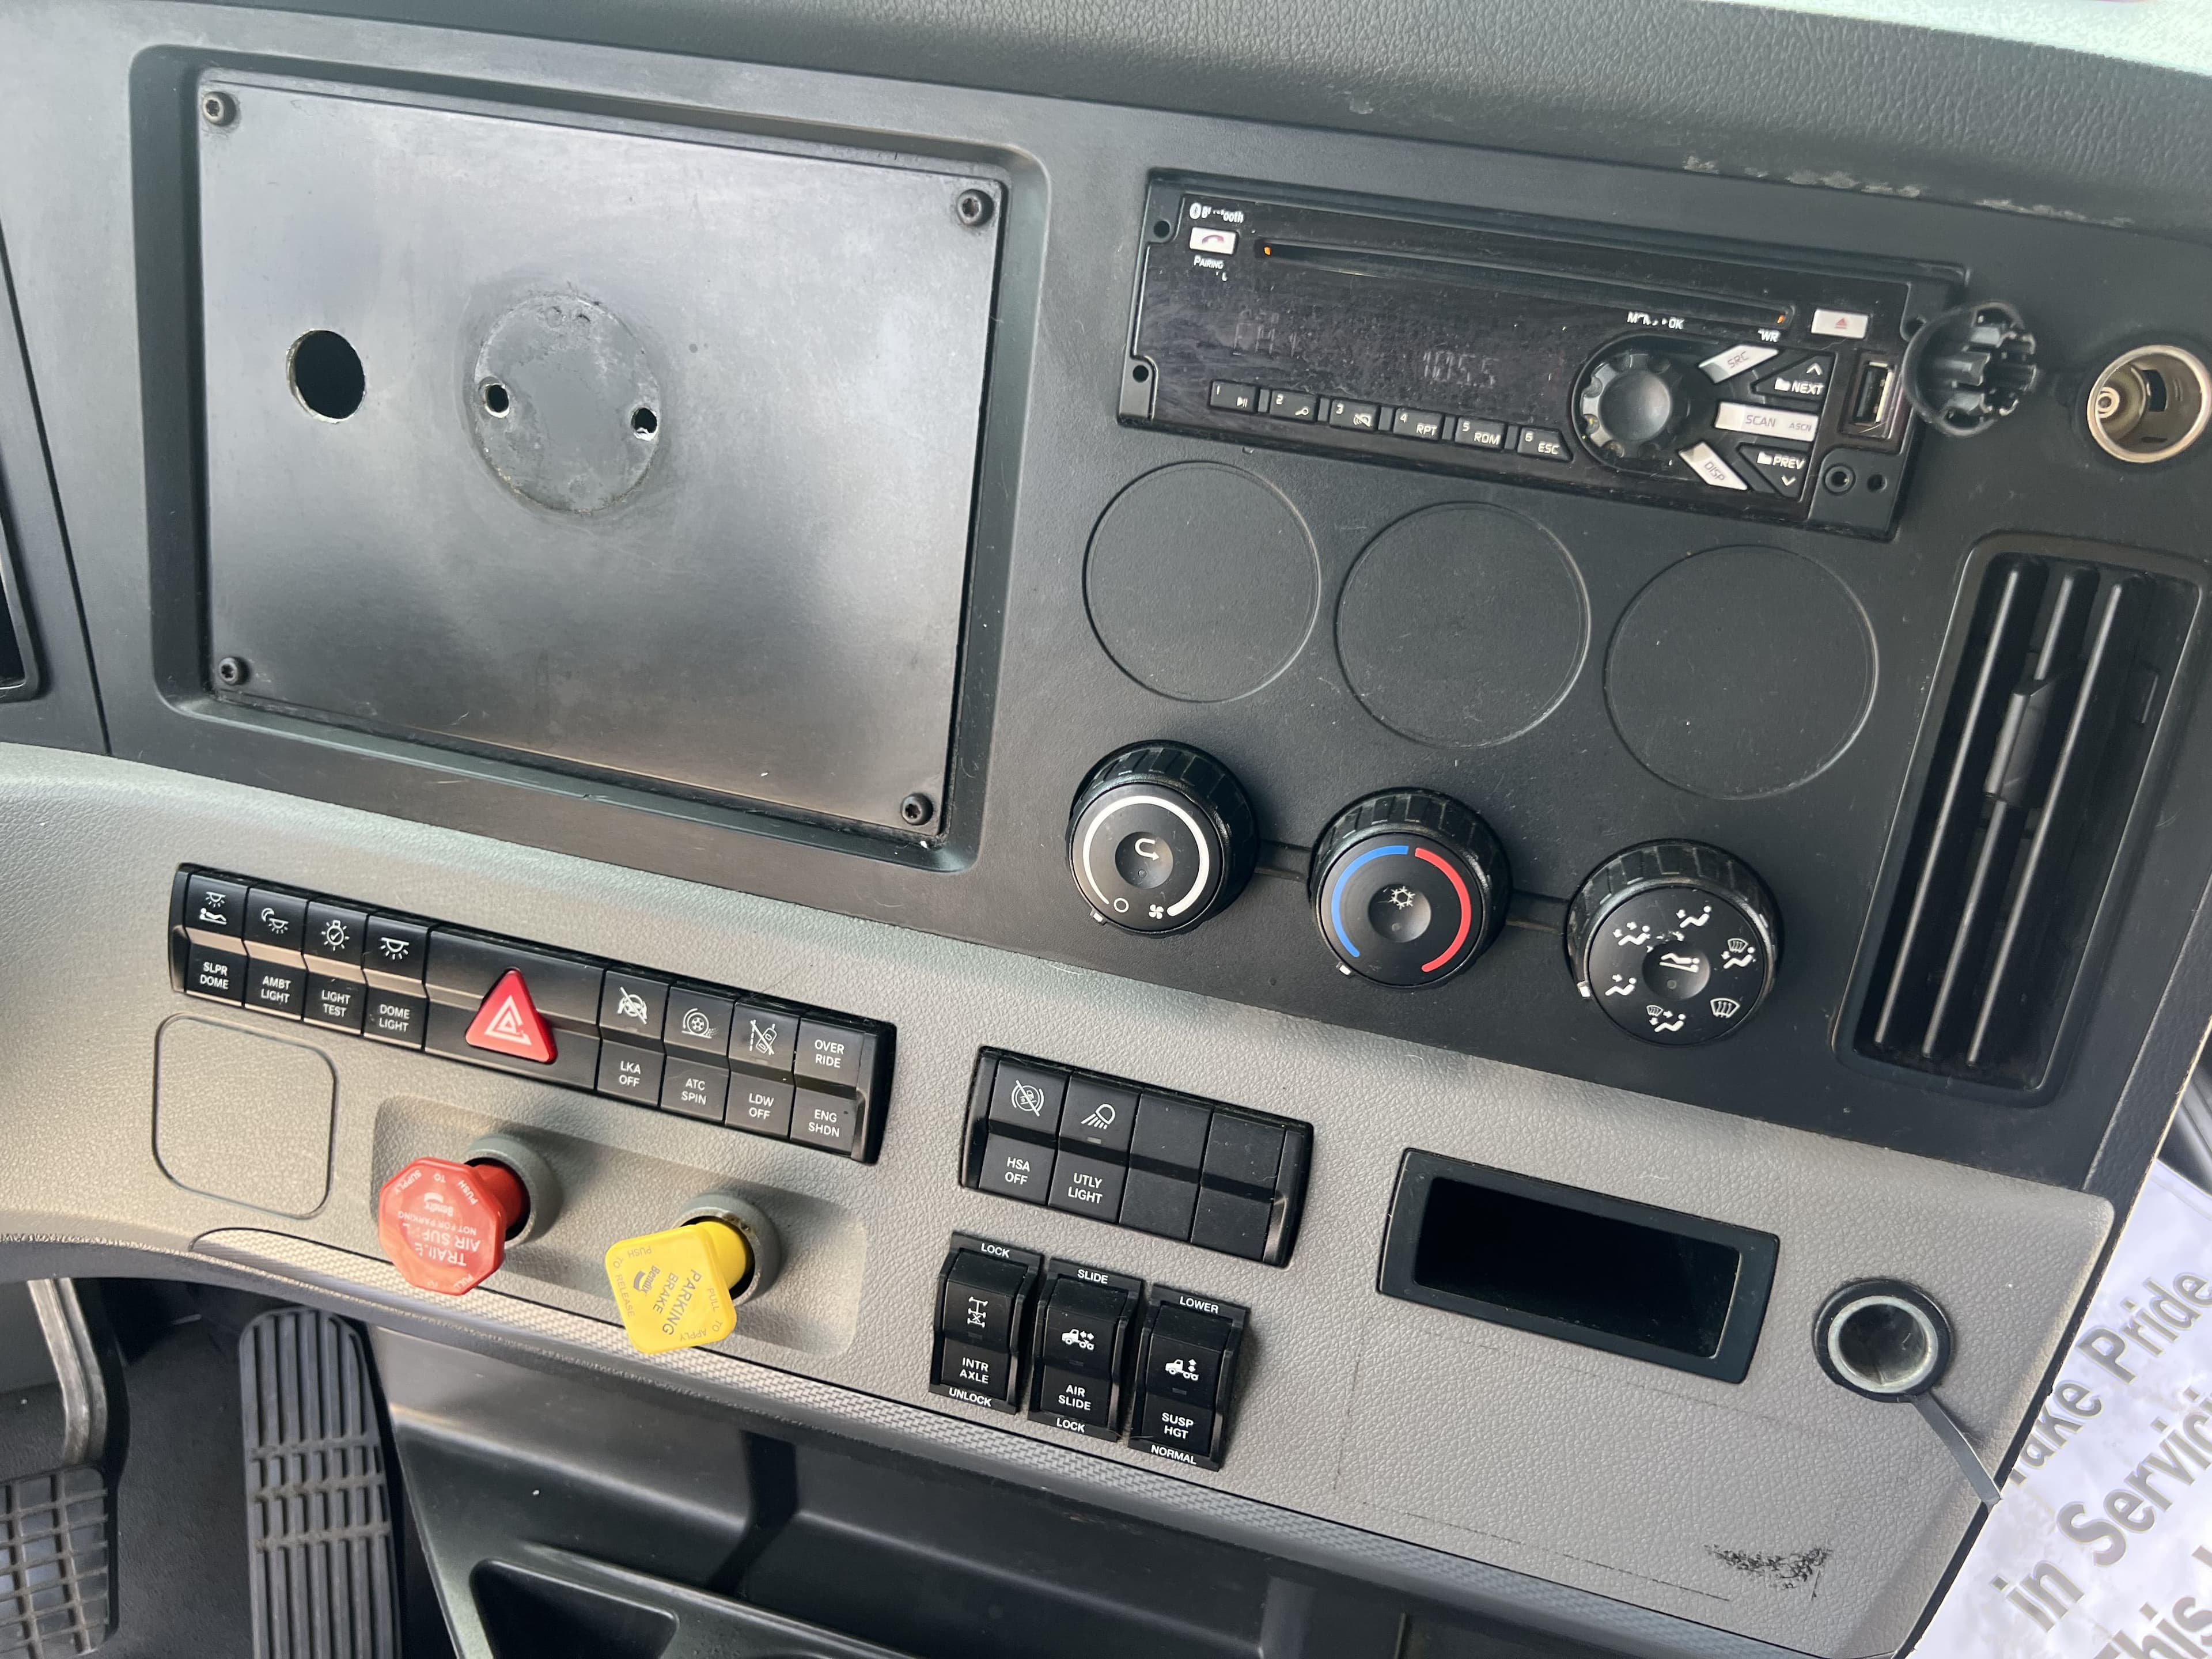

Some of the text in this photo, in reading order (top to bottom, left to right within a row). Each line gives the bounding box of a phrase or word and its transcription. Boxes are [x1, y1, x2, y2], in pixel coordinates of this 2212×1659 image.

[1668, 316, 1684, 329] OK
[1727, 351, 1749, 369] SRC
[1215, 385, 1221, 396] 1
[1791, 381, 1824, 395] NEXT
[1275, 393, 1283, 405] 2
[1336, 403, 1344, 414] 3
[1399, 412, 1438, 437] 4 RPT
[1461, 421, 1470, 433] 5
[1745, 415, 1776, 428] SCAN
[1524, 432, 1559, 455] 6 ESC
[1772, 456, 1805, 470] PREV
[1705, 461, 1725, 482] DISP
[203, 961, 228, 976] SLPR
[199, 972, 229, 990] DOME
[262, 975, 291, 990] AMBT
[260, 988, 290, 1003] LIGHT
[321, 989, 350, 1005] LIGHT
[323, 1003, 347, 1018] TEST
[380, 1003, 410, 1020] DOME
[378, 1016, 408, 1032] LIGHT
[815, 1039, 844, 1055] OVER
[620, 1060, 641, 1074] LKA
[815, 1053, 841, 1068] RIDE
[619, 1074, 640, 1087] OFF
[685, 1078, 706, 1091] ATC
[681, 1091, 706, 1105] SPIN
[748, 1093, 774, 1107] LDW
[749, 1106, 771, 1120] OFF
[814, 1109, 837, 1123] ENG
[808, 1122, 840, 1137] SHDN
[1006, 1157, 1031, 1172] HSA
[1005, 1171, 1028, 1185] OFF
[1073, 1172, 1103, 1188] UTLY
[394, 1169, 478, 1205] PUSH TO SUPPLY
[1067, 1186, 1103, 1205] LIGHT
[397, 1211, 477, 1235] NOT FOR PARKING
[454, 1237, 481, 1252] AIR
[981, 1243, 1010, 1258] LOCK
[613, 1245, 652, 1317] PUSH TO RELEASE
[641, 1266, 661, 1294] Bendix
[1077, 1268, 1108, 1285] SLIDE
[653, 1272, 679, 1313] BRAKE
[662, 1270, 702, 1335] PARKING
[1179, 1296, 1219, 1314] LOWER
[680, 1288, 723, 1342] PULL TO APPLY
[2075, 1272, 2212, 1384] Pride
[961, 1357, 989, 1372] INTR
[959, 1369, 989, 1384] AXLE
[949, 1387, 992, 1407] UNLOCK
[1066, 1384, 1085, 1397] AIR
[1058, 1395, 1091, 1411] SLIDE
[1056, 1417, 1085, 1433] LOCK
[1161, 1412, 1194, 1428] SUSP
[1164, 1424, 1189, 1440] HGT
[1151, 1445, 1197, 1465] NORMAL
[1989, 1560, 2084, 1632] in
